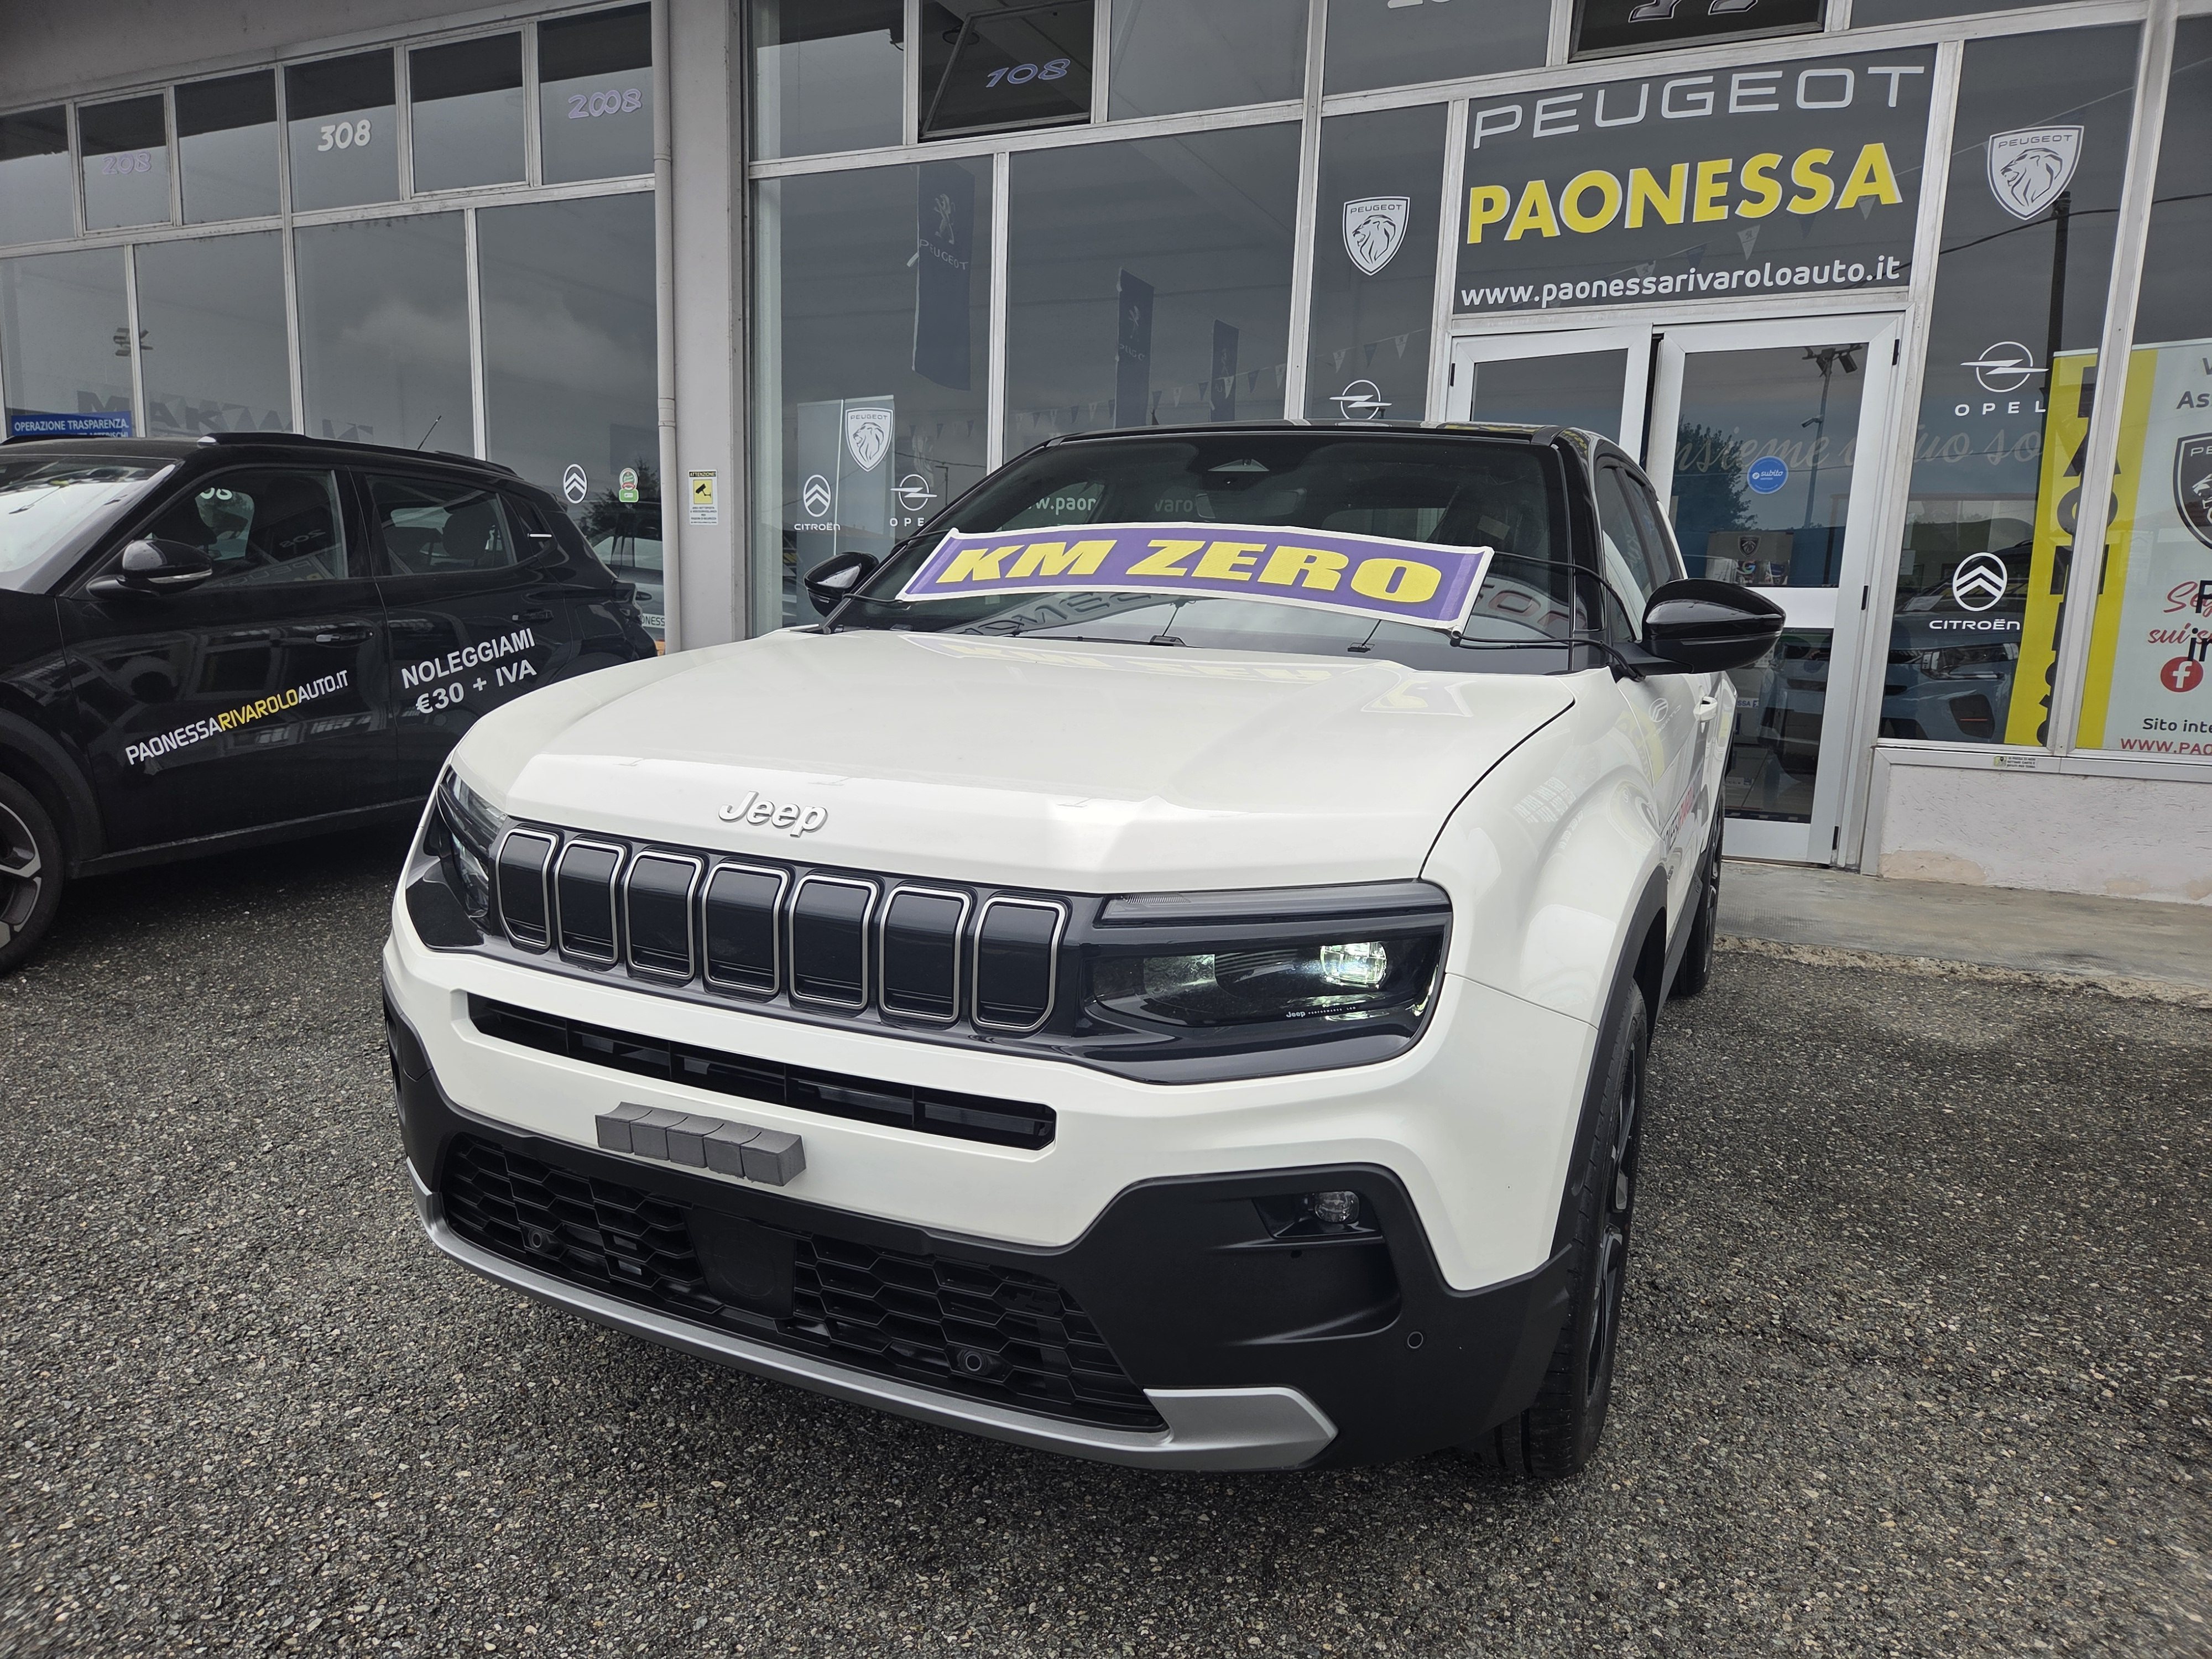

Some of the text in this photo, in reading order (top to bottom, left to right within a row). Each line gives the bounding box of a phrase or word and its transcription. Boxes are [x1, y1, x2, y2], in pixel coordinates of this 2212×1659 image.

[985, 58, 1071, 87] 108
[568, 88, 642, 118] 2008
[1473, 66, 1924, 149] PEUGEOT
[317, 119, 371, 152] 308
[1999, 134, 2073, 149] PEUGEOT
[103, 151, 152, 175] 208
[1467, 142, 1903, 244] PAONESSA
[1350, 204, 1402, 214] PEUGEOT
[919, 239, 969, 270] PEUGEOT
[1461, 255, 1900, 307] www.paonessarivaroloauto.it
[1954, 401, 2046, 416] OPEL
[14, 421, 65, 431] OPERAZIONE
[794, 522, 841, 531] CITROËN
[890, 518, 925, 527] OPE
[936, 539, 1442, 603] KM ZERO
[1929, 619, 2020, 630] CITROËN
[401, 628, 535, 689] NOLEGGIAMI
[415, 681, 465, 714] €30
[495, 659, 537, 687] IVA
[125, 670, 348, 765] PAONESSARIVAROLOAUTO.IT
[2142, 718, 2177, 731] Sito
[718, 791, 828, 838] Jeep
